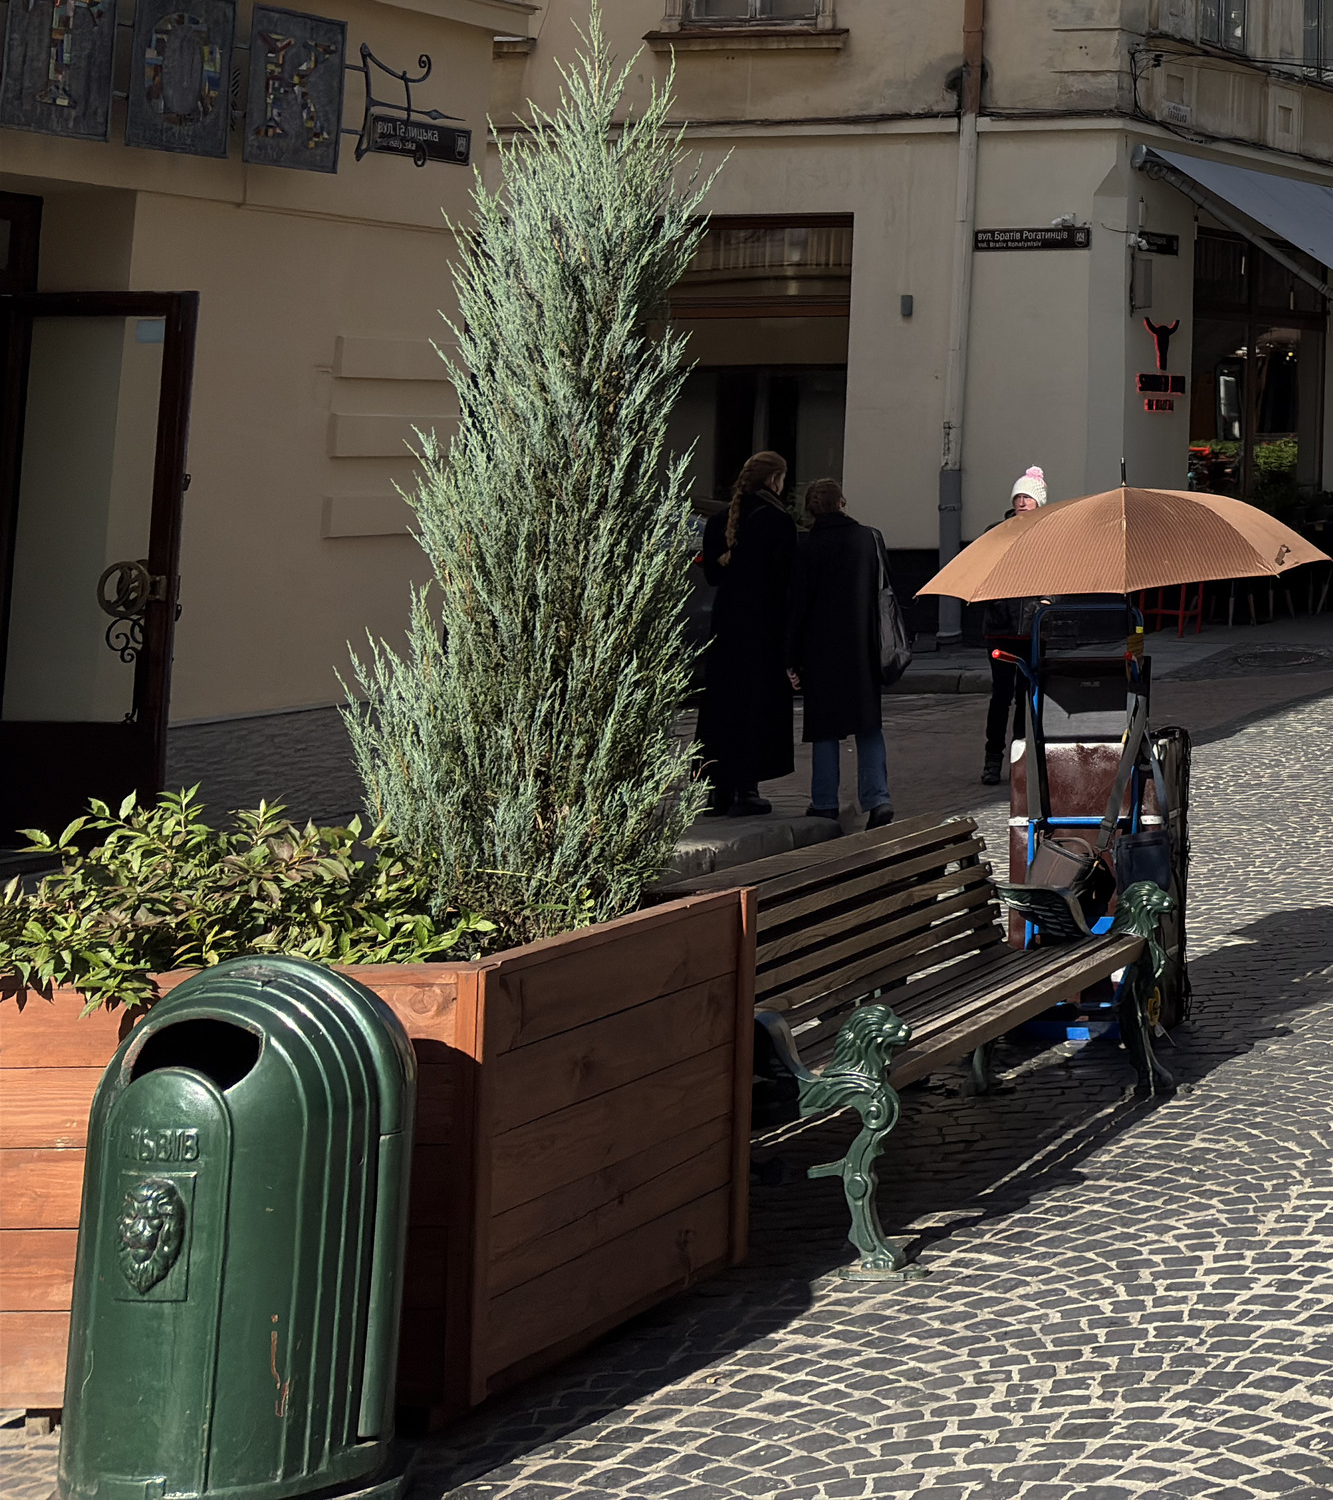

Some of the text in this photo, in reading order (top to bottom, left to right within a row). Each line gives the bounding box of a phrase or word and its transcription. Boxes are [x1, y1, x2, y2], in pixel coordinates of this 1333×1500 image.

[396, 121, 439, 142] Галицька
[994, 231, 1021, 241] Братів
[1023, 230, 1068, 240] Рогатинців
